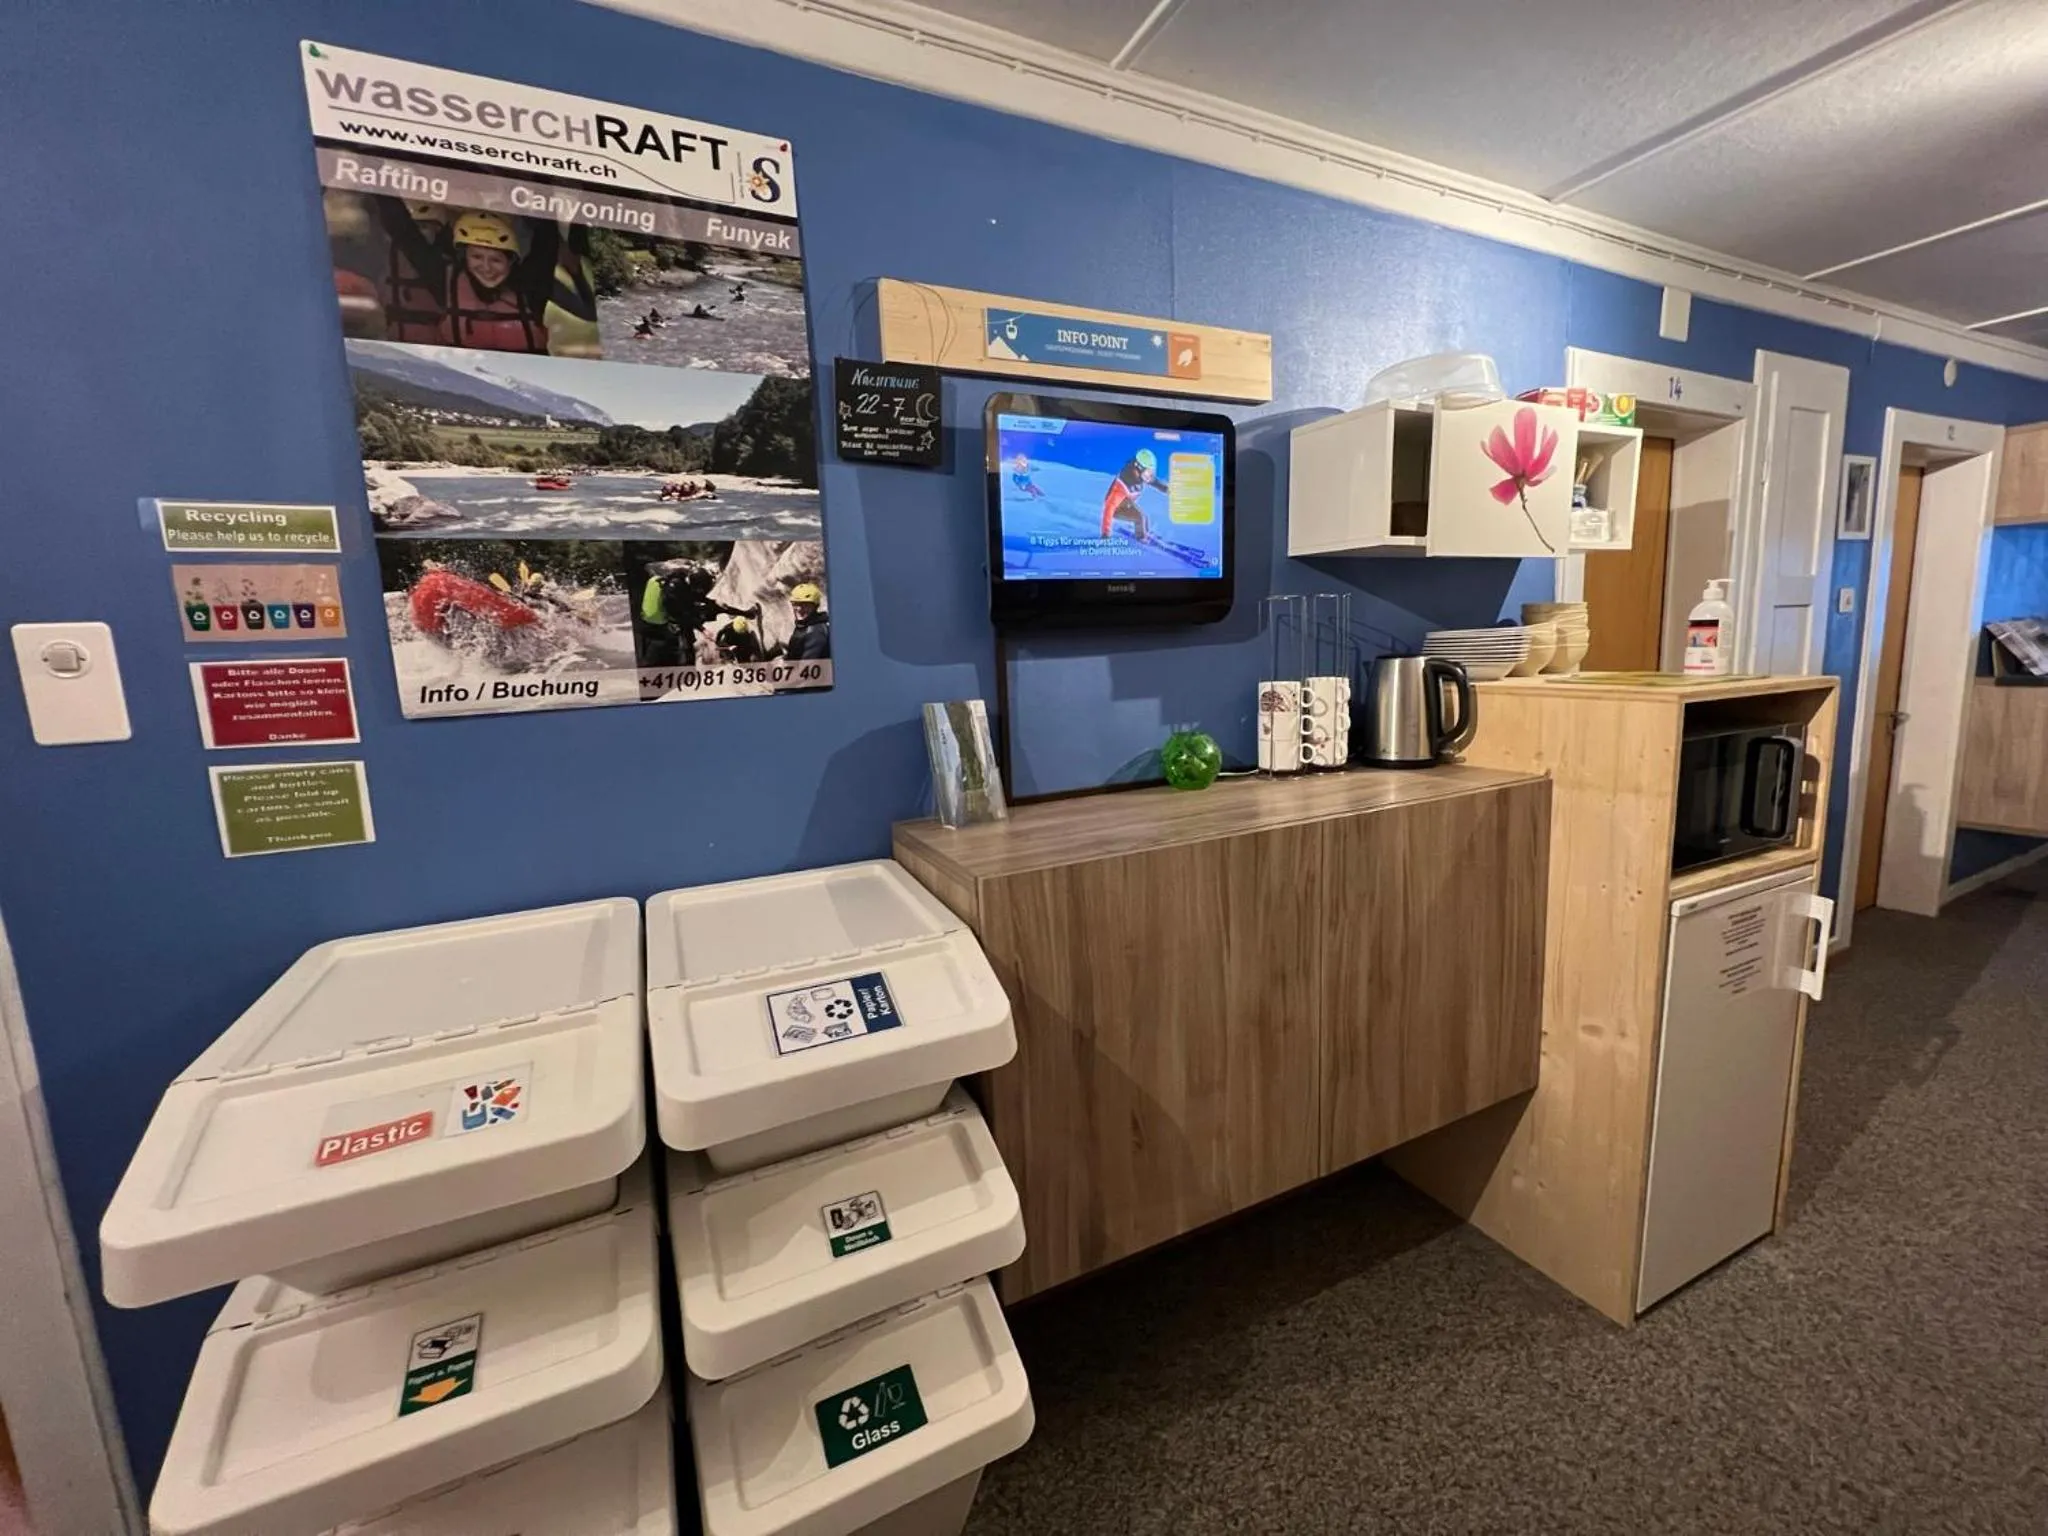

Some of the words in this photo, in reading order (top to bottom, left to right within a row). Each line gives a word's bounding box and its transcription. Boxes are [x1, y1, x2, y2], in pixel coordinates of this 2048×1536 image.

[340, 119, 618, 180] www.wasserchraft.ch
[335, 158, 449, 200] Rafting
[511, 186, 656, 232] Canyoning
[706, 219, 792, 251] Funyak
[1056, 328, 1089, 345] INFO
[1091, 333, 1128, 351] POINT
[1669, 377, 1684, 400] 14
[856, 393, 880, 415] 22
[893, 397, 906, 418] 7
[185, 508, 288, 527] Recycling
[168, 528, 213, 542] Please
[216, 530, 245, 544] help
[249, 532, 264, 542] us
[268, 530, 281, 542] to
[284, 532, 334, 545] recycle.
[228, 668, 259, 677] Bitte
[262, 668, 285, 676] alle
[288, 667, 326, 675] Dosen
[244, 679, 301, 687] Flaschen
[639, 669, 725, 692] +41(0)81
[732, 668, 766, 685] 936
[772, 666, 795, 683] 07
[798, 664, 822, 681] 40
[419, 684, 470, 705] Info
[475, 682, 486, 702] /
[492, 679, 599, 702] Buchung
[268, 732, 307, 741] Danke
[873, 985, 893, 1016] Karton
[320, 1120, 424, 1160] Plastic
[851, 1420, 901, 1450] Glass
